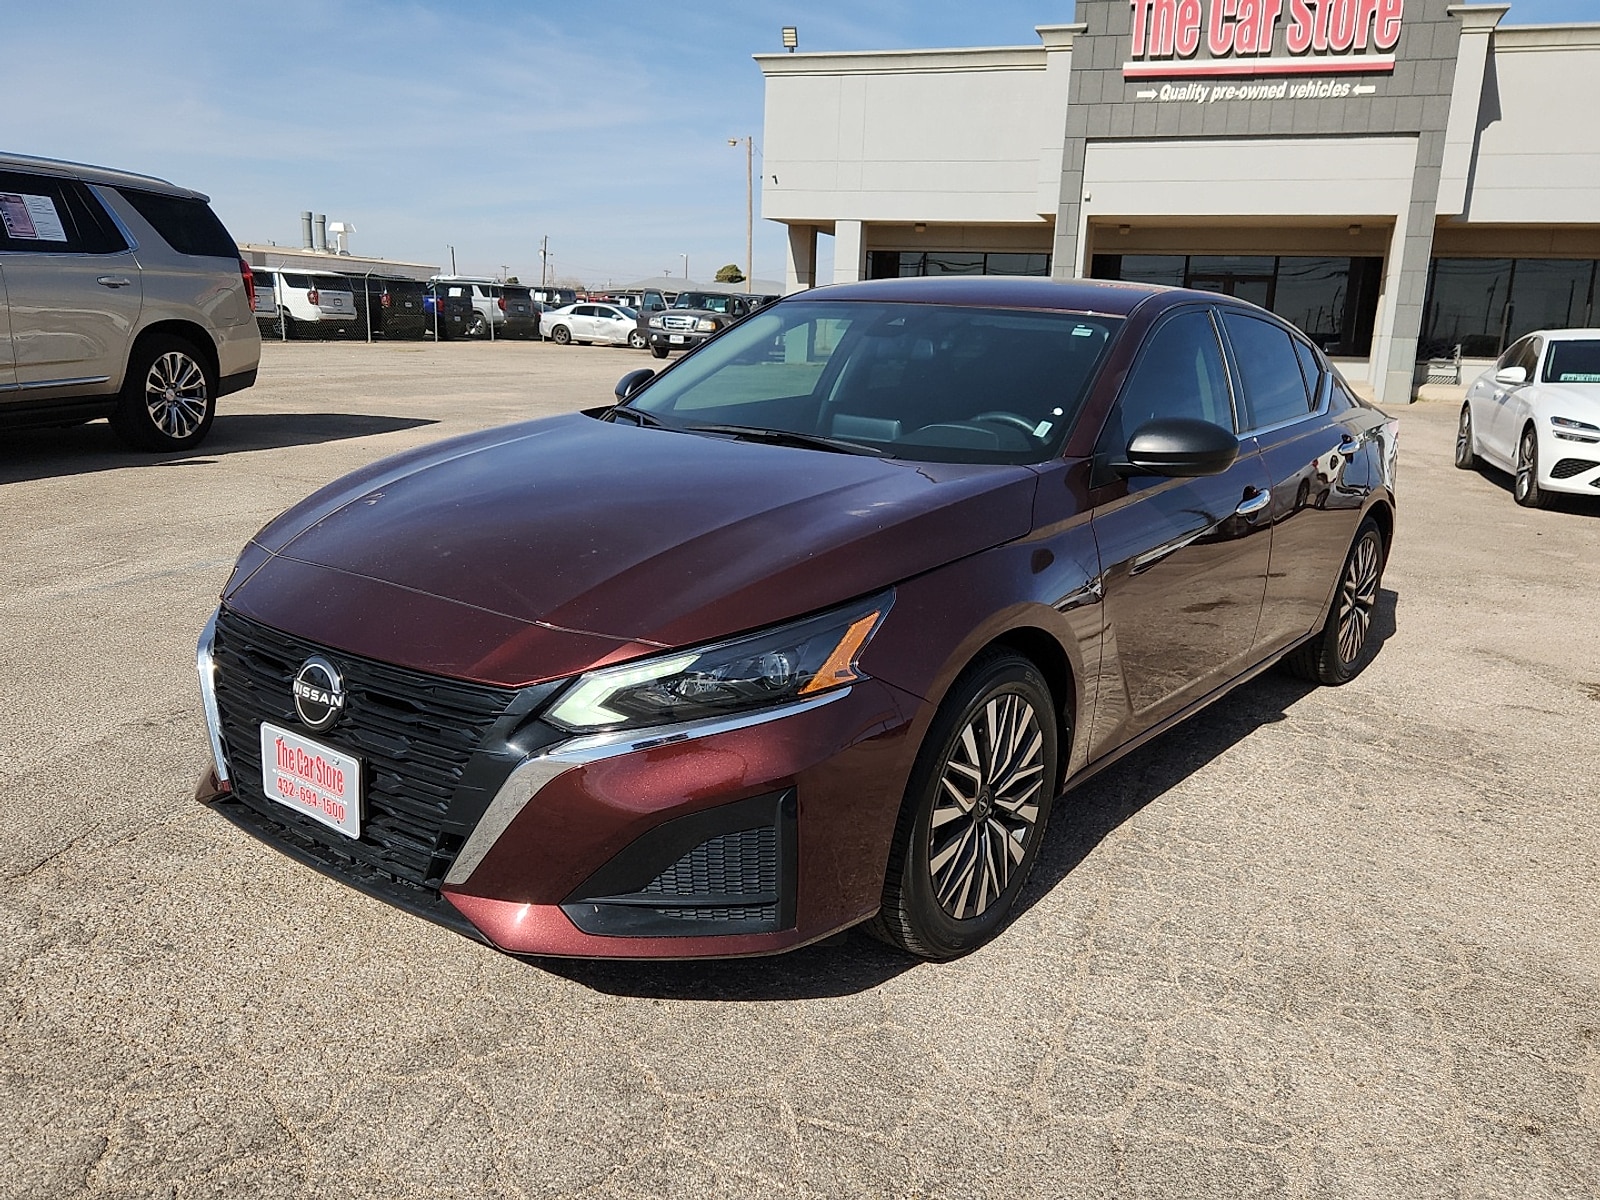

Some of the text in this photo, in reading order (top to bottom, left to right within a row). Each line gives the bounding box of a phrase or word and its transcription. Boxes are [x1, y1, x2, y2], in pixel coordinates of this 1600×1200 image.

[1131, 0, 1404, 56] The Car Store
[1159, 80, 1351, 104] Quality pre-owned vehicles
[294, 680, 343, 707] NISSAN
[275, 739, 344, 794] The Car Store
[277, 777, 345, 823] 432-694-1500
